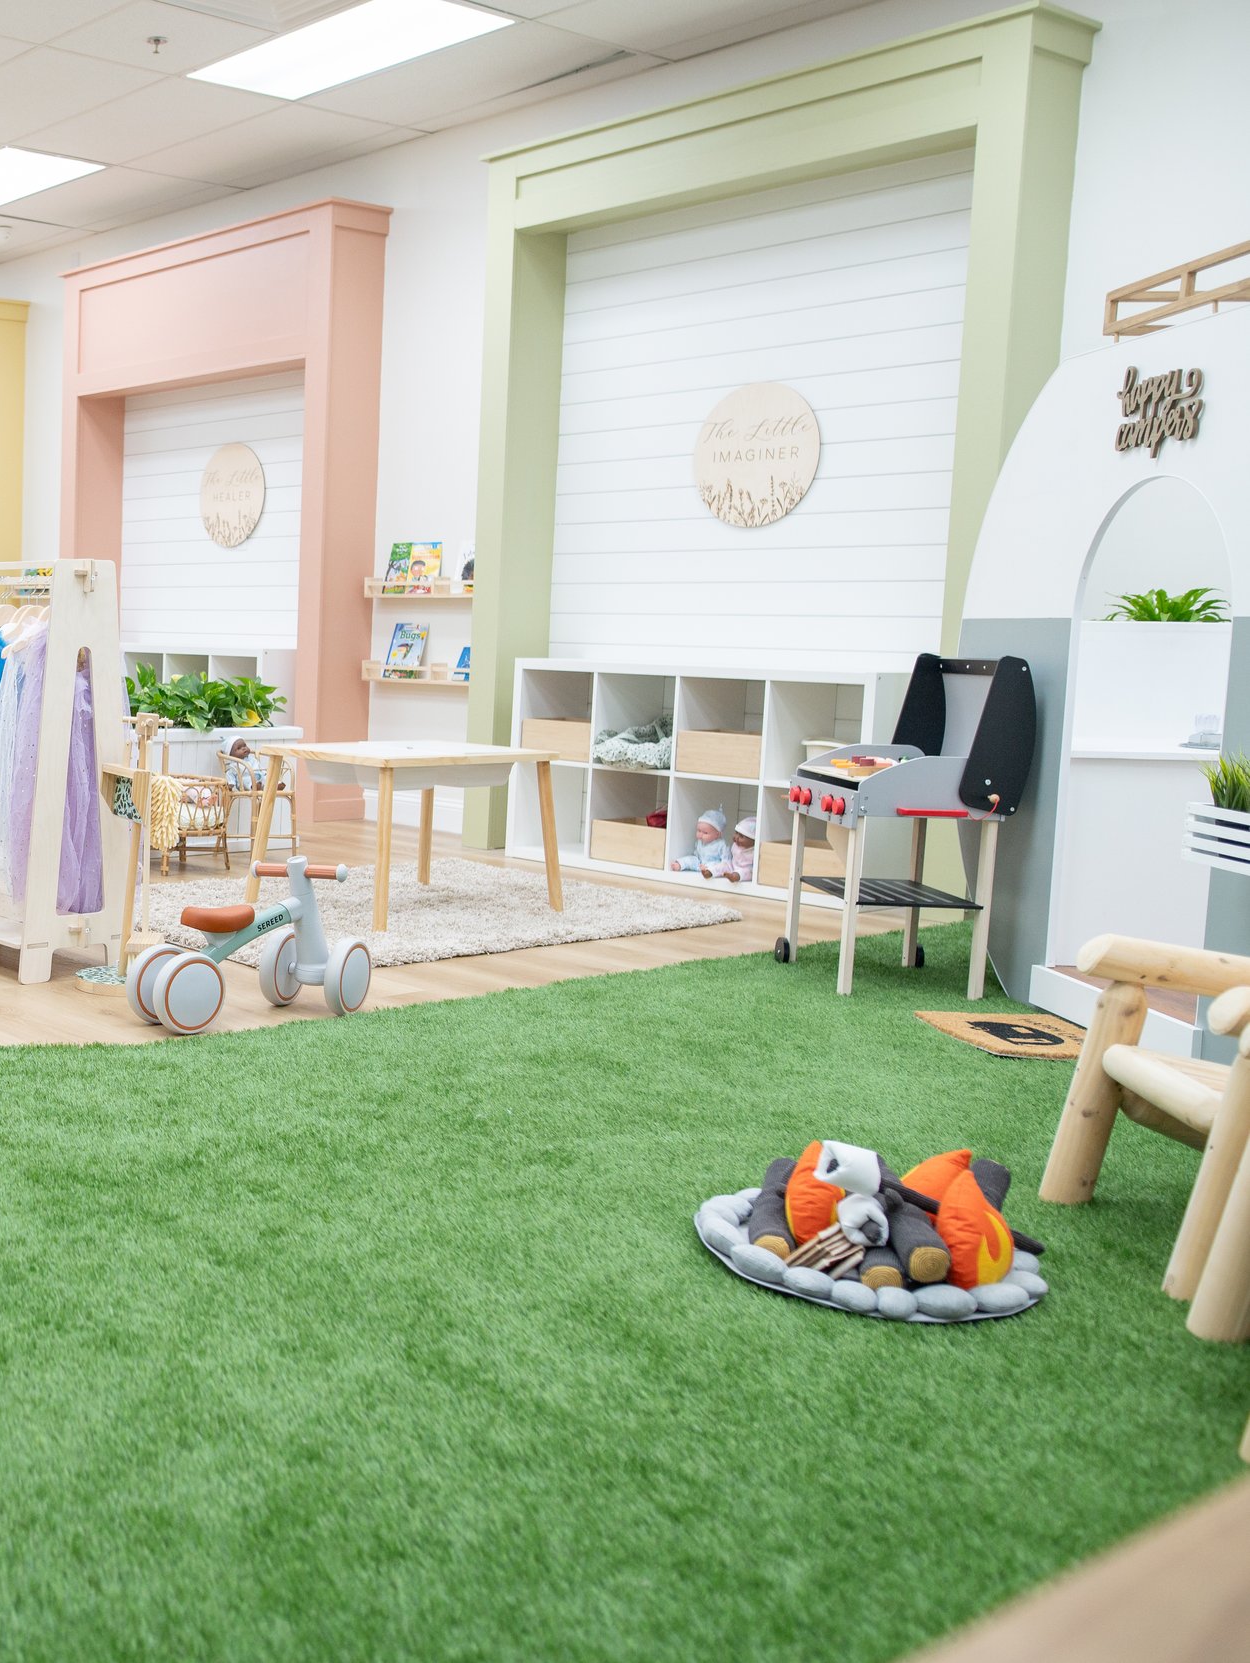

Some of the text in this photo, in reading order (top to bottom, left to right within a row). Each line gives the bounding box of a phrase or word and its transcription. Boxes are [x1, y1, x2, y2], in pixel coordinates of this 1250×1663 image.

[1117, 366, 1203, 419] happy
[703, 411, 814, 444] The Little
[1115, 399, 1204, 459] campers
[712, 446, 800, 463] IMAGINER
[203, 466, 262, 487] The Little
[213, 490, 251, 502] HEALER
[399, 630, 421, 641] Bugs
[257, 913, 284, 932] SEREED
